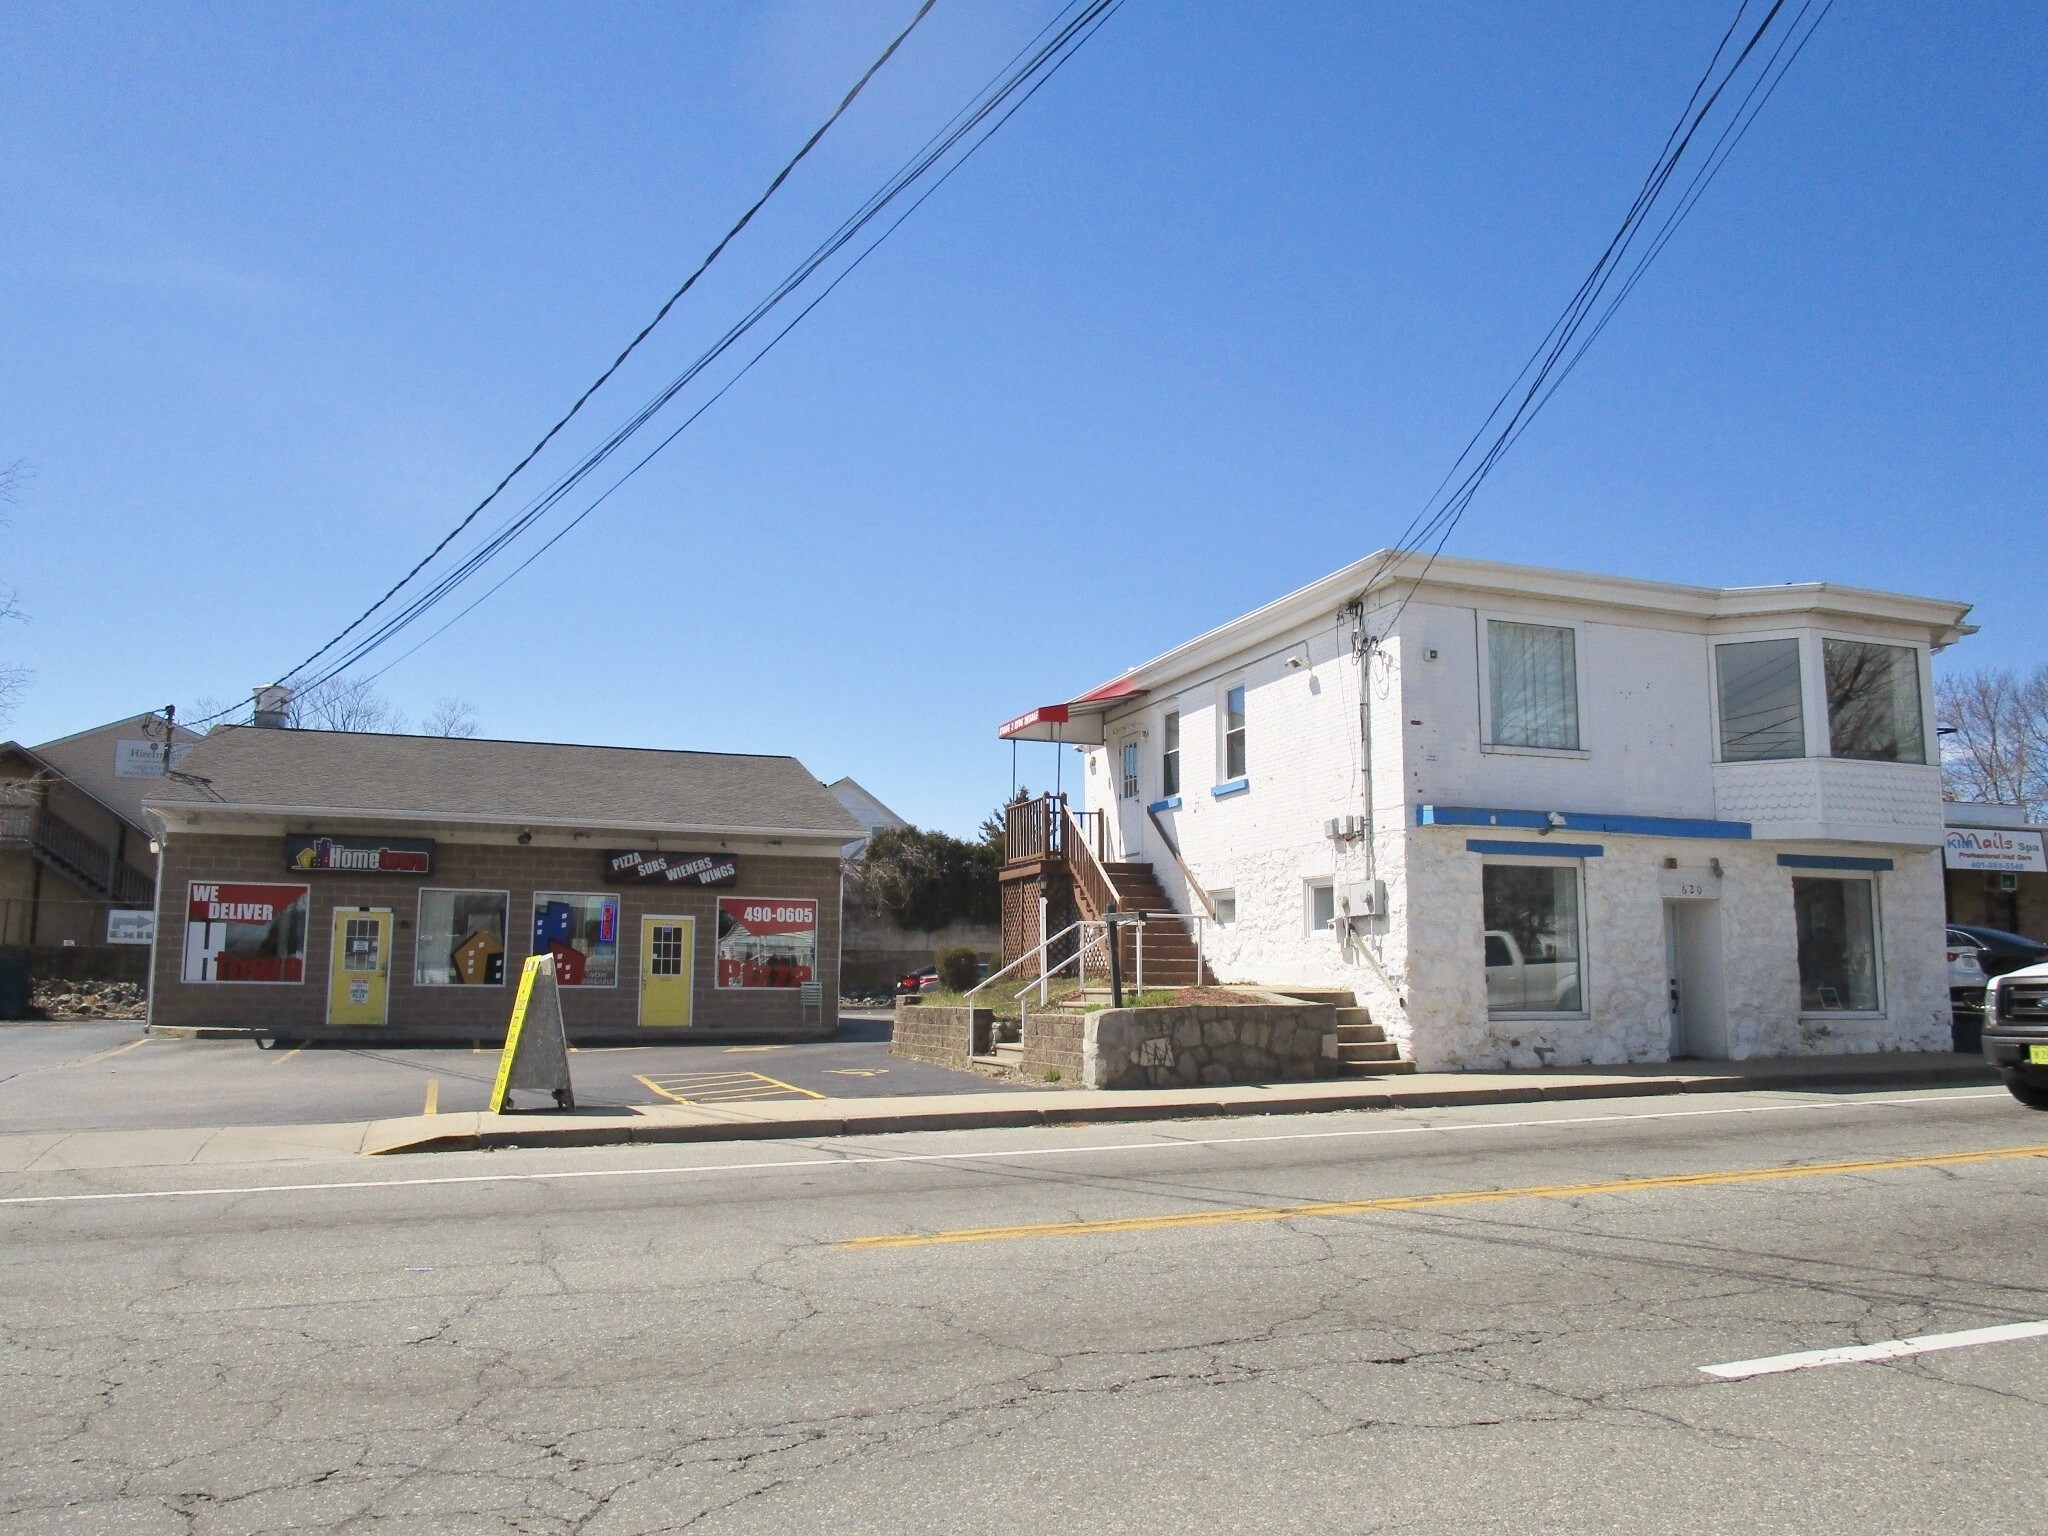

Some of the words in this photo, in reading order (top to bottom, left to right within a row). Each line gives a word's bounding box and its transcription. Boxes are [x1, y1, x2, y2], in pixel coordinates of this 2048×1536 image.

[1946, 832, 2013, 850] Nails
[1946, 838, 1974, 849] KIM
[2018, 842, 2039, 853] Spa
[612, 852, 642, 870] PIZZA
[638, 858, 667, 876] SUBS
[665, 857, 713, 881] WIENERS
[699, 864, 735, 884] WINGS
[193, 885, 219, 901] WE
[1682, 885, 1702, 894] 620
[208, 903, 273, 920] DELIVER
[744, 907, 812, 922] 490-0605
